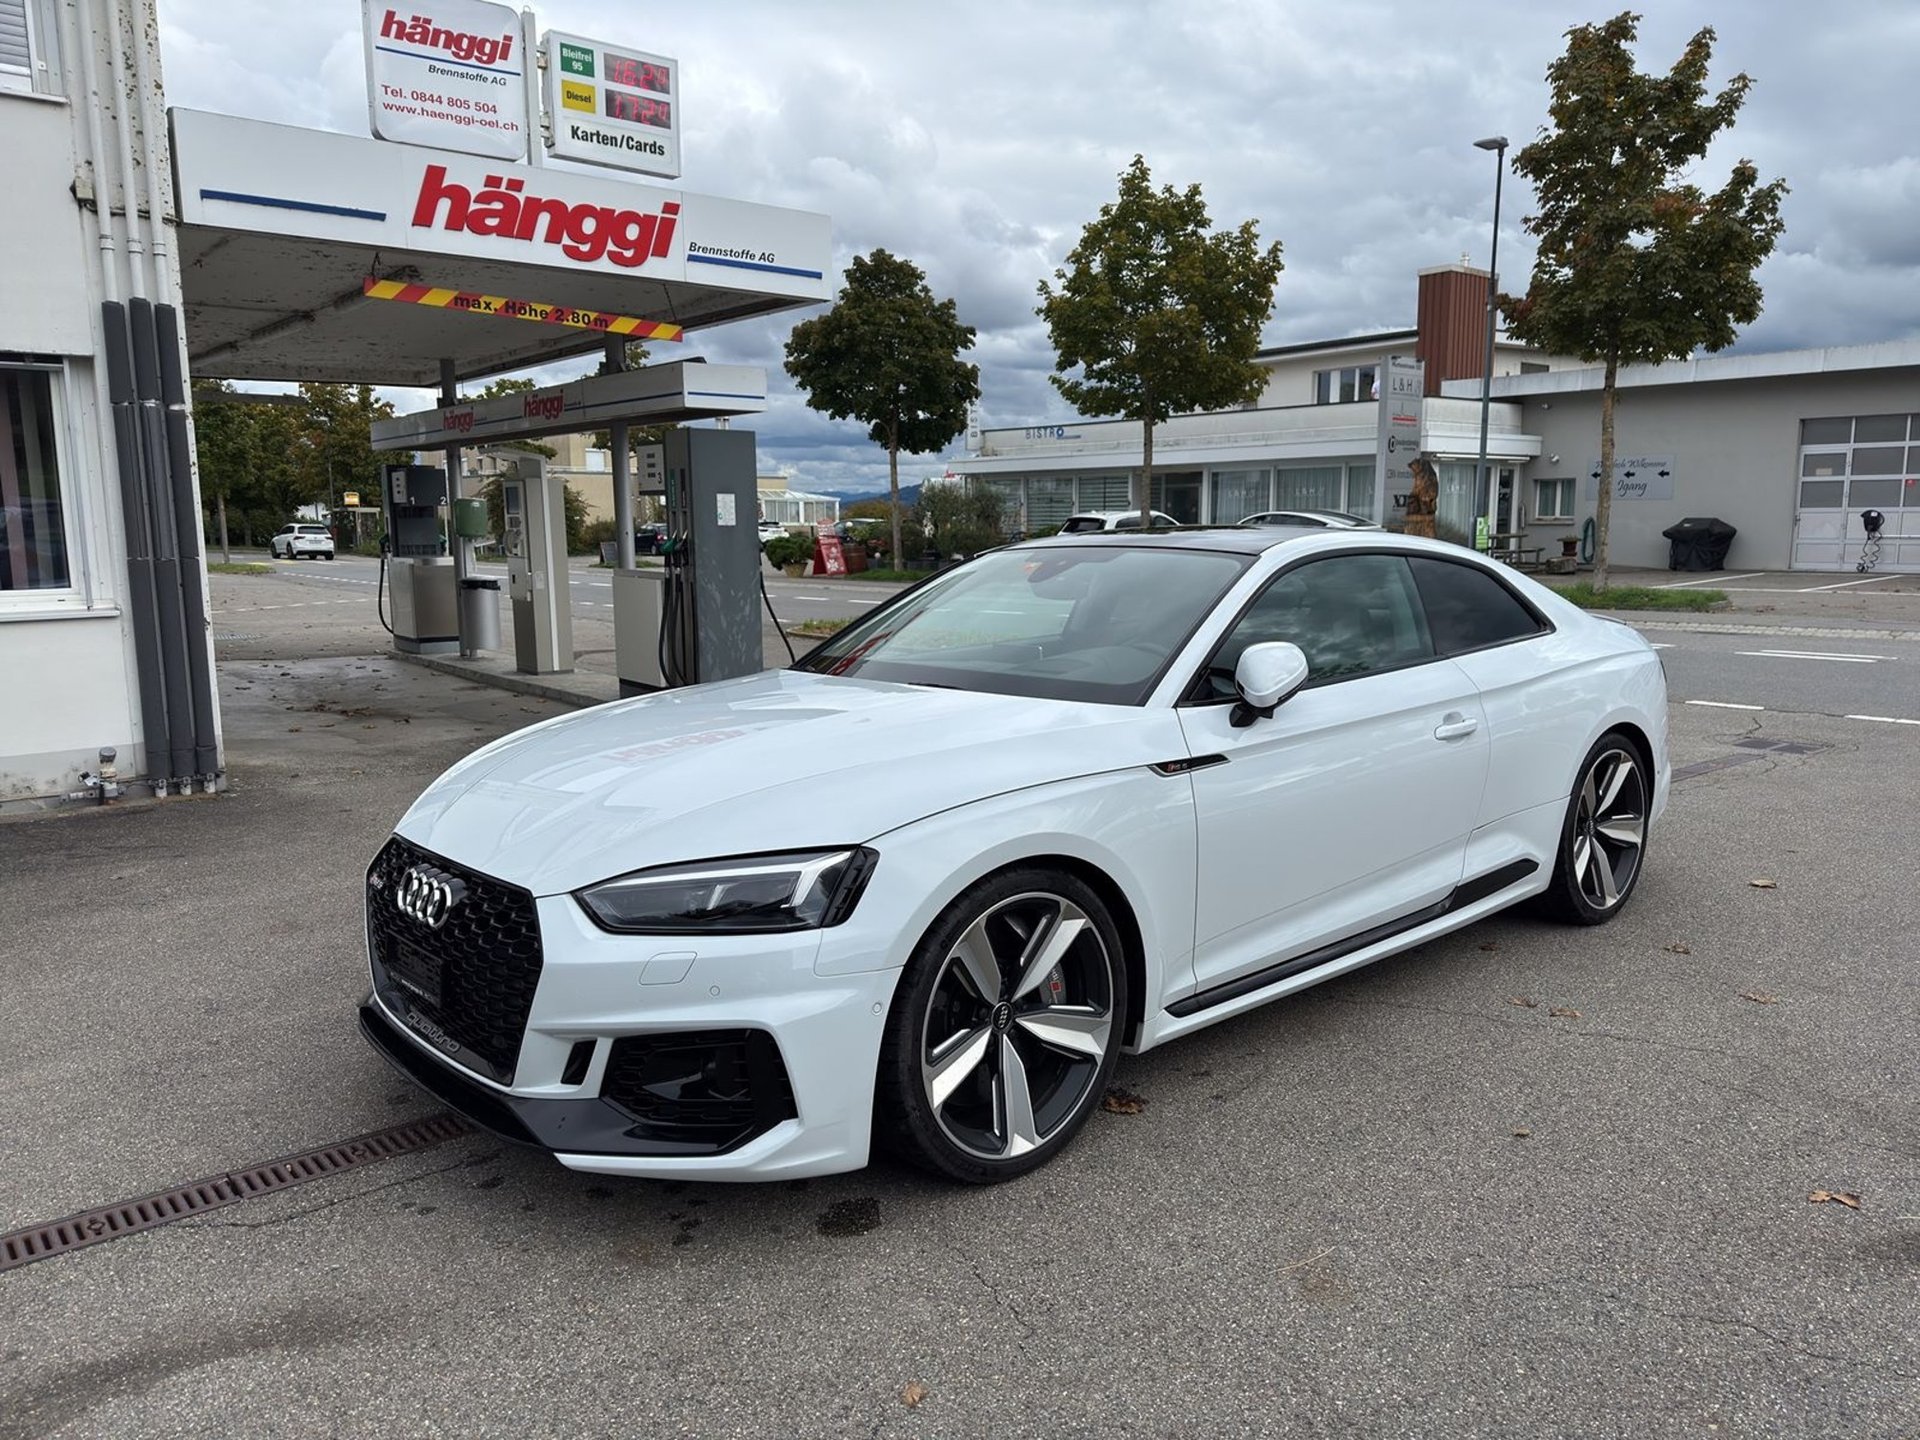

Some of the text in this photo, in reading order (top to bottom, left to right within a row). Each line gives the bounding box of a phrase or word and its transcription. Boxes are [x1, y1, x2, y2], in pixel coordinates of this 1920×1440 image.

[380, 9, 513, 65] hänggi
[562, 48, 593, 62] Bleifrei
[571, 60, 583, 71] 95
[428, 64, 507, 86] Brennstoffe AG
[381, 84, 497, 114] Tel. 0844 805 504
[566, 90, 592, 103] Diesel
[382, 102, 519, 131] www.haenggi-oel.ch
[571, 125, 666, 156] Karten/Cards
[412, 164, 681, 268] hänggi
[688, 242, 775, 264] Brennstoffe AG
[453, 295, 498, 311] max.
[504, 300, 549, 319] Höhe
[523, 389, 564, 420] hänggi
[443, 406, 474, 432] hänggi
[1025, 426, 1064, 439] BISTRO
[410, 496, 416, 504] 1
[440, 496, 447, 505] 2
[407, 1012, 461, 1052] quattro
